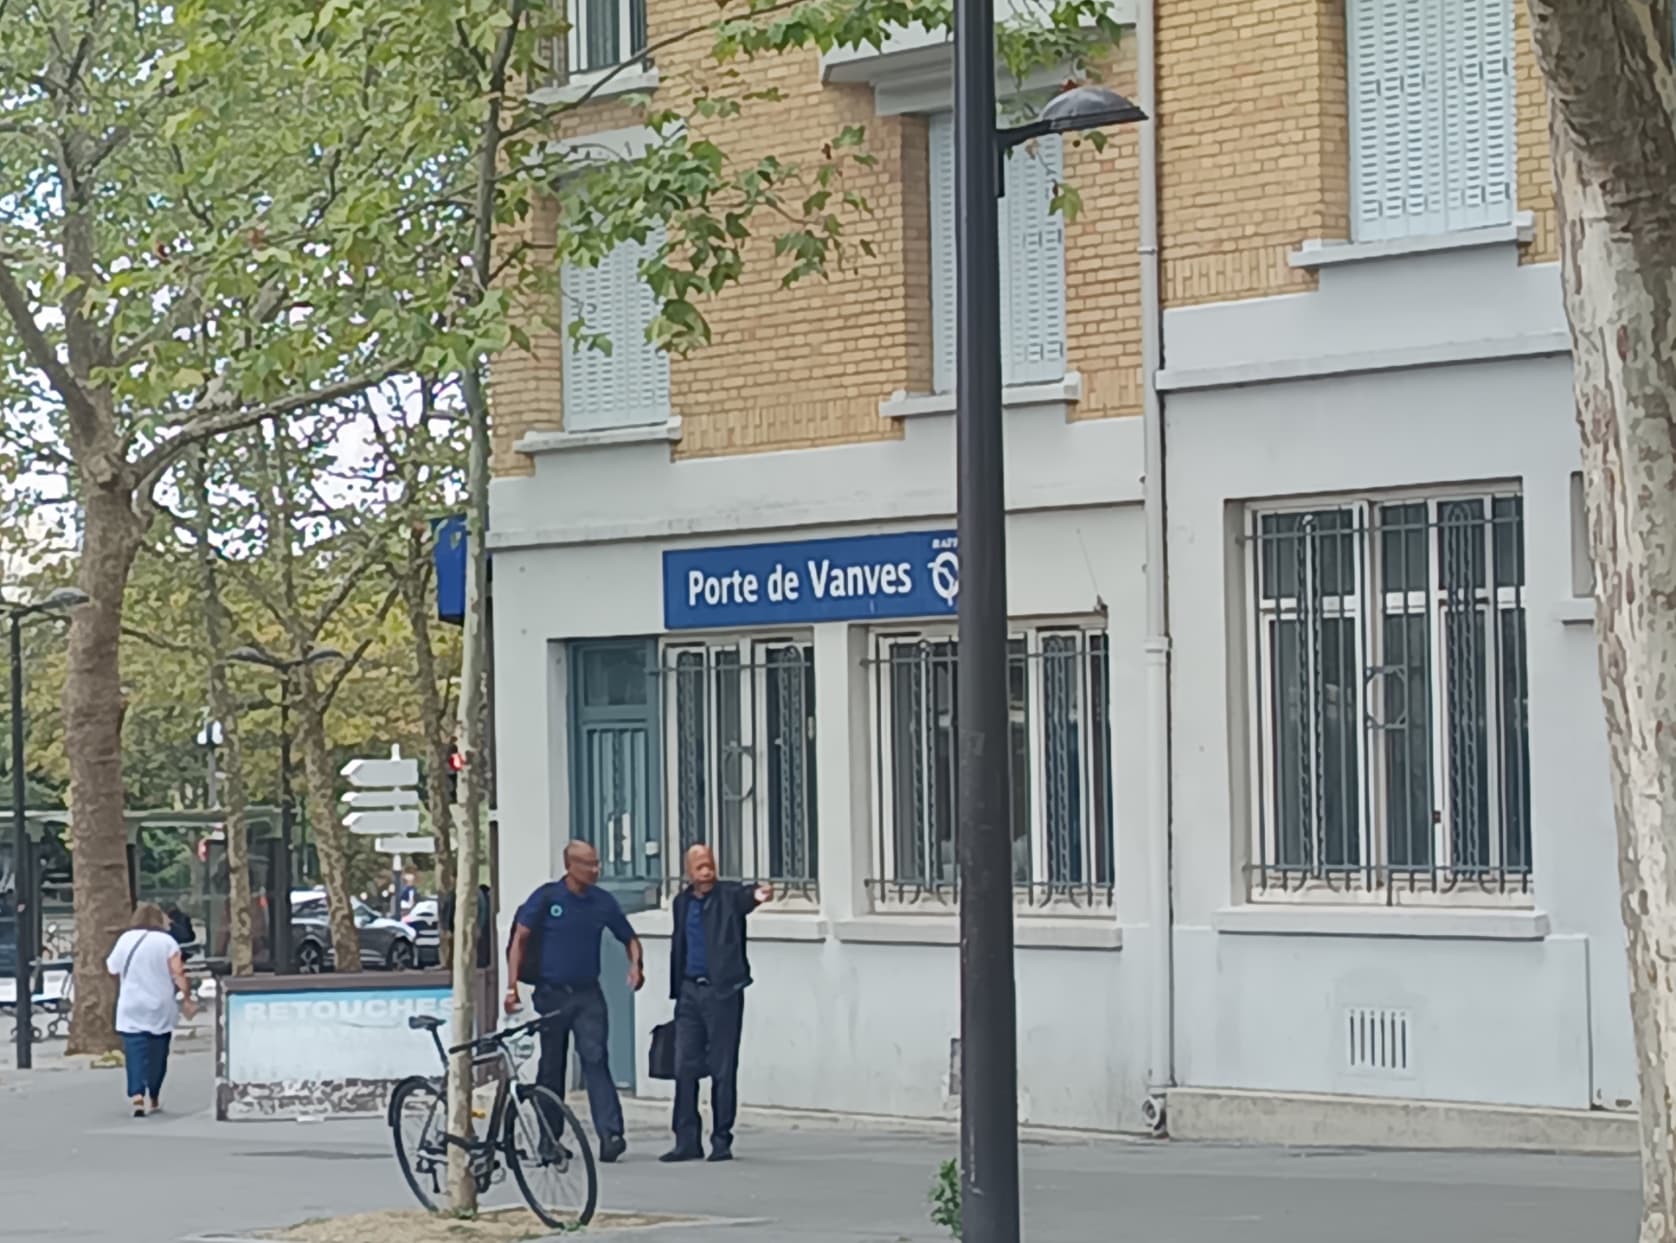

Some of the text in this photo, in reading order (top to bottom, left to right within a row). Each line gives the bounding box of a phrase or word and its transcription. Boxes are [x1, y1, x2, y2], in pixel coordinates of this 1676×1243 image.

[688, 559, 912, 606] Porte de Vanves
[244, 997, 455, 1021] RETOUCHES
